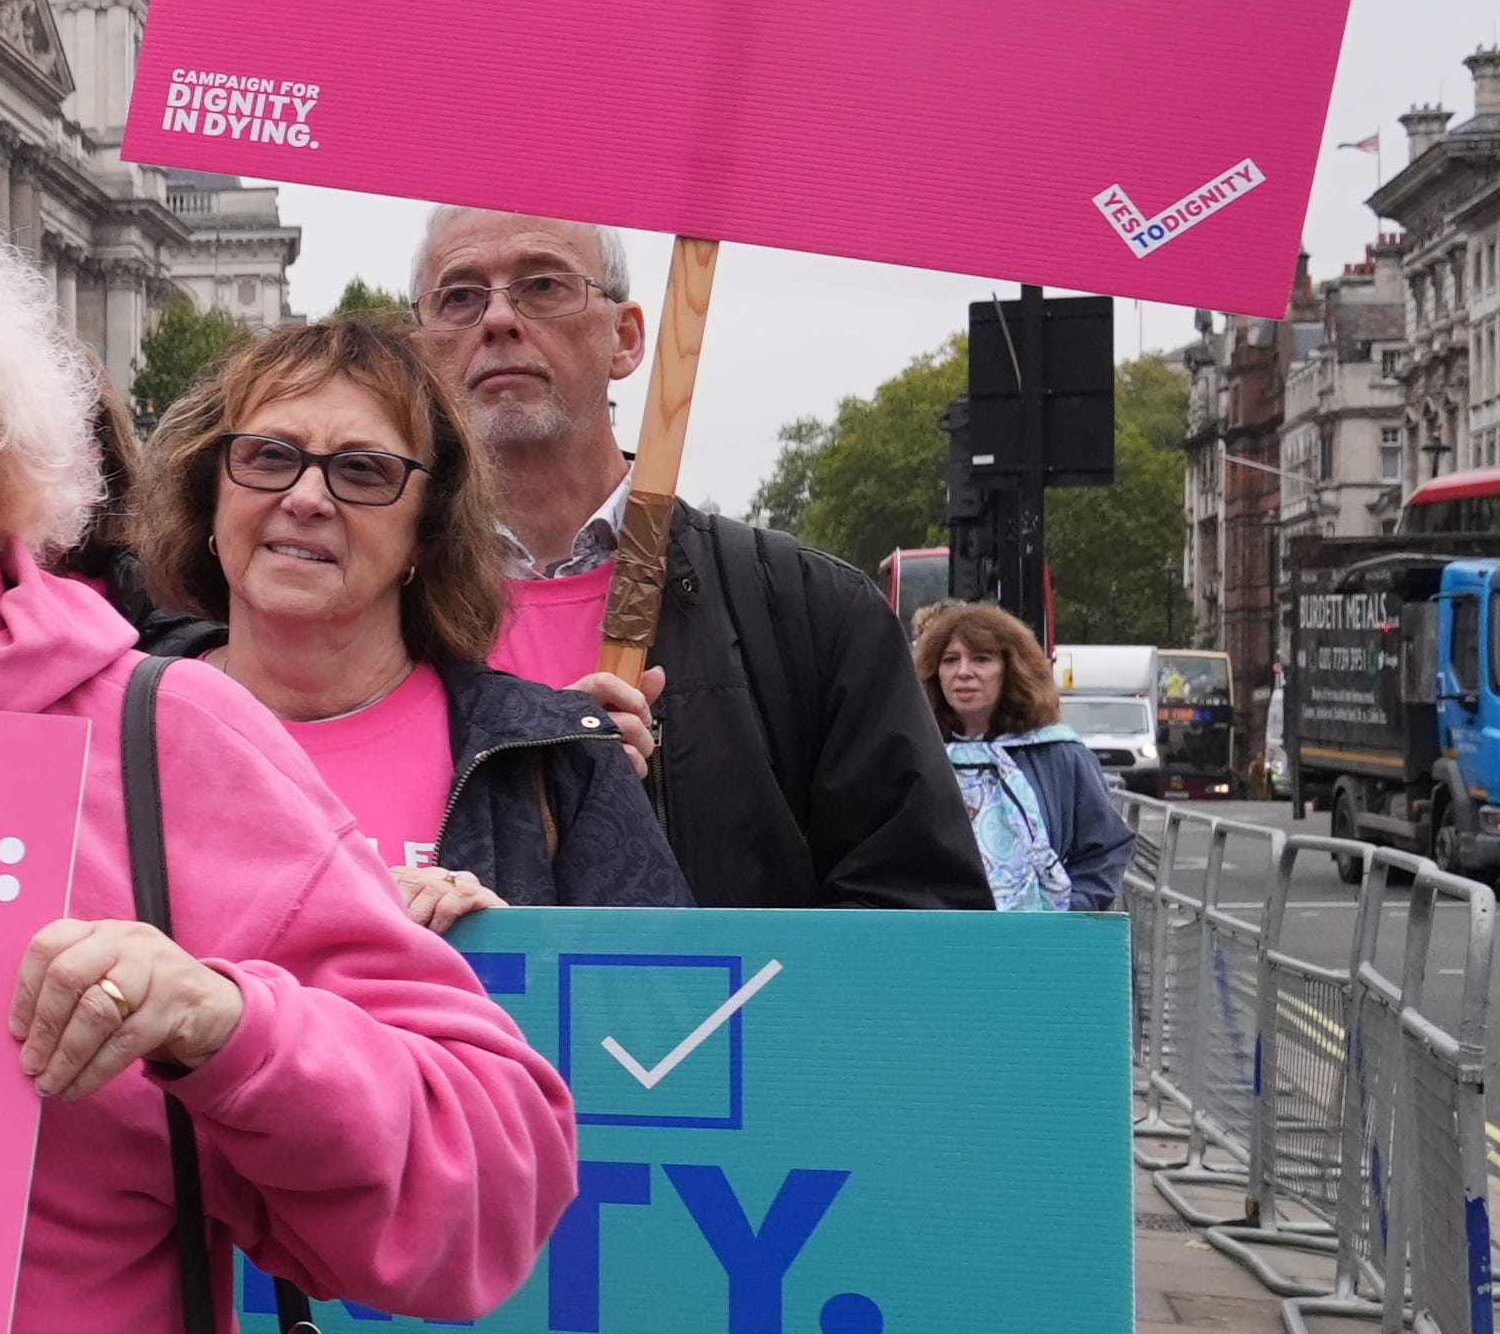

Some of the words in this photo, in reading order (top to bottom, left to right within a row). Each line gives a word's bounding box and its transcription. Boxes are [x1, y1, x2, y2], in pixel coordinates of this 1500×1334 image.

[167, 82, 317, 122] DIGNITY
[172, 68, 275, 93] CAMPAIGN
[280, 81, 320, 99] FOR
[162, 107, 198, 133] IN
[203, 113, 320, 149] DYING.
[1104, 191, 1141, 234] YES
[1345, 592, 1387, 630] METALS
